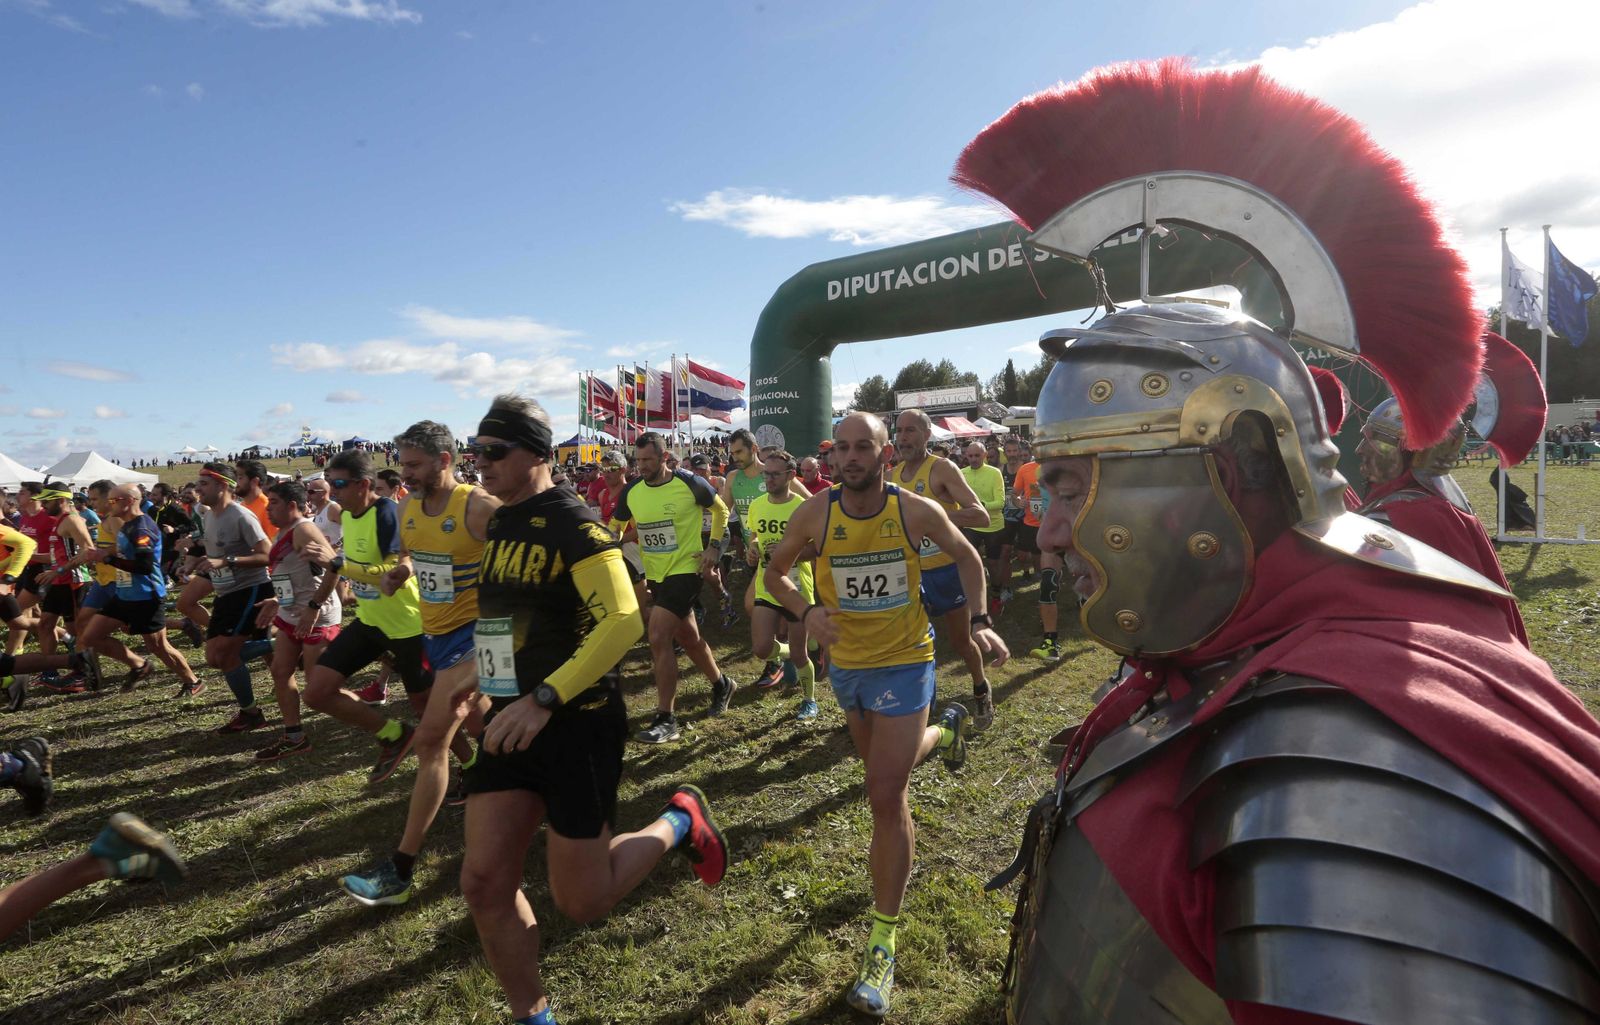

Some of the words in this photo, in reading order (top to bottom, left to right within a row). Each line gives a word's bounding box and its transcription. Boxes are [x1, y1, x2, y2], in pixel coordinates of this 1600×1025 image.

[827, 251, 981, 301] DIPUTACION
[987, 242, 1023, 271] DE
[756, 377, 778, 386] CROSS
[757, 519, 788, 534] 369
[644, 533, 666, 546] 636
[880, 552, 903, 560] SEVILLA
[420, 570, 437, 592] 65
[846, 574, 890, 599] 542
